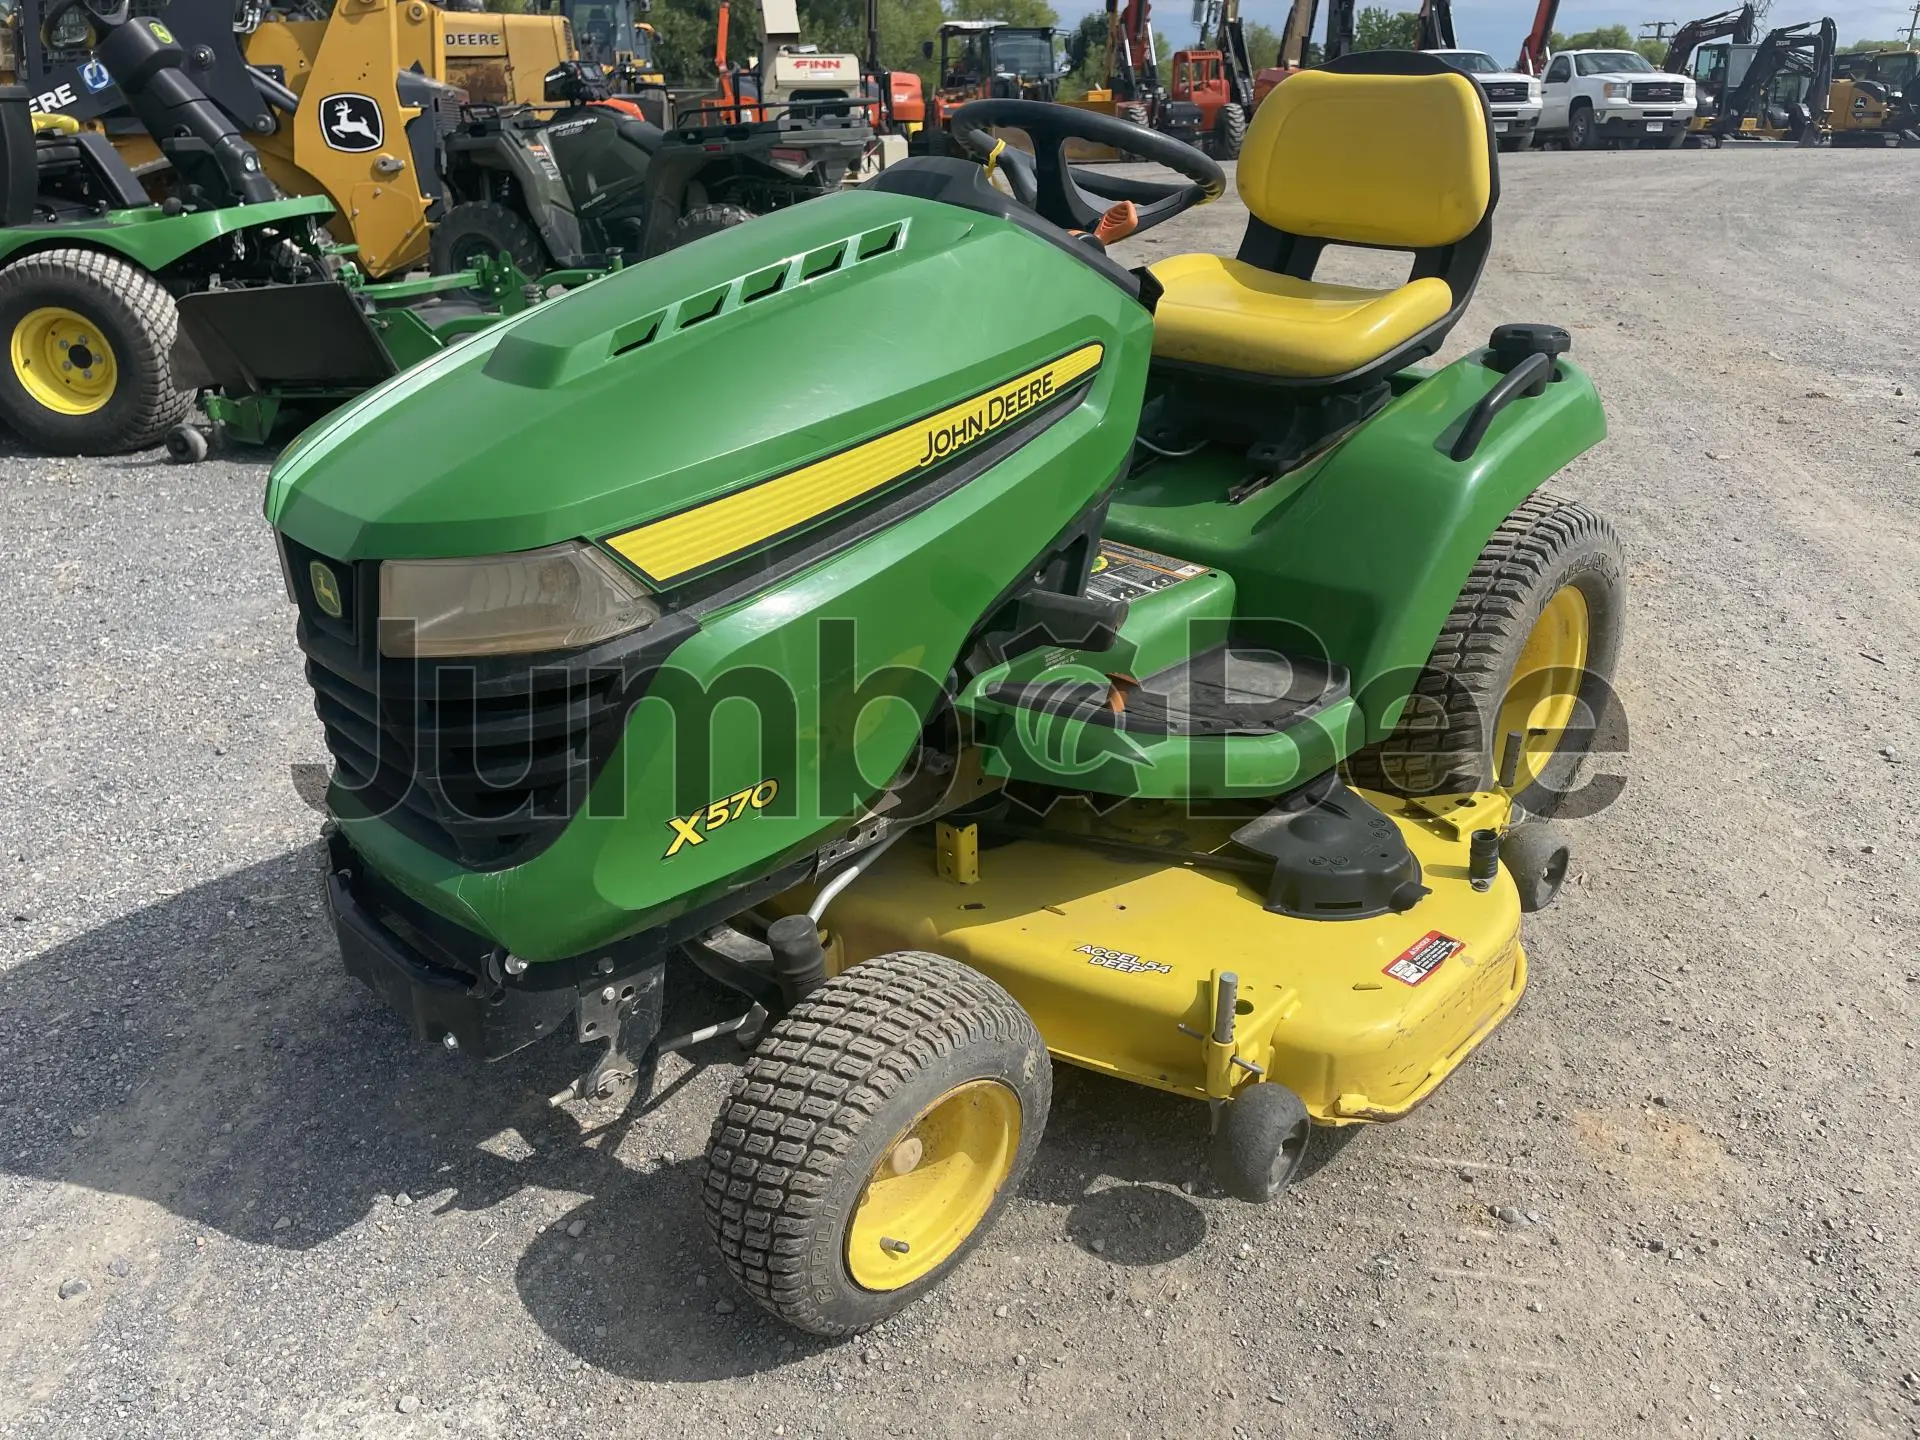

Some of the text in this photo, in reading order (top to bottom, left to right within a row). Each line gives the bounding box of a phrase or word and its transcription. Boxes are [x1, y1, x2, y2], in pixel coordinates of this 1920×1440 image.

[445, 33, 500, 46] DEERE
[793, 60, 841, 69] FINN
[919, 370, 1055, 466] JOHN DEERE
[661, 778, 779, 860] X570
[1073, 944, 1173, 974] ACCEL 54
[1089, 956, 1146, 973] DEEP
